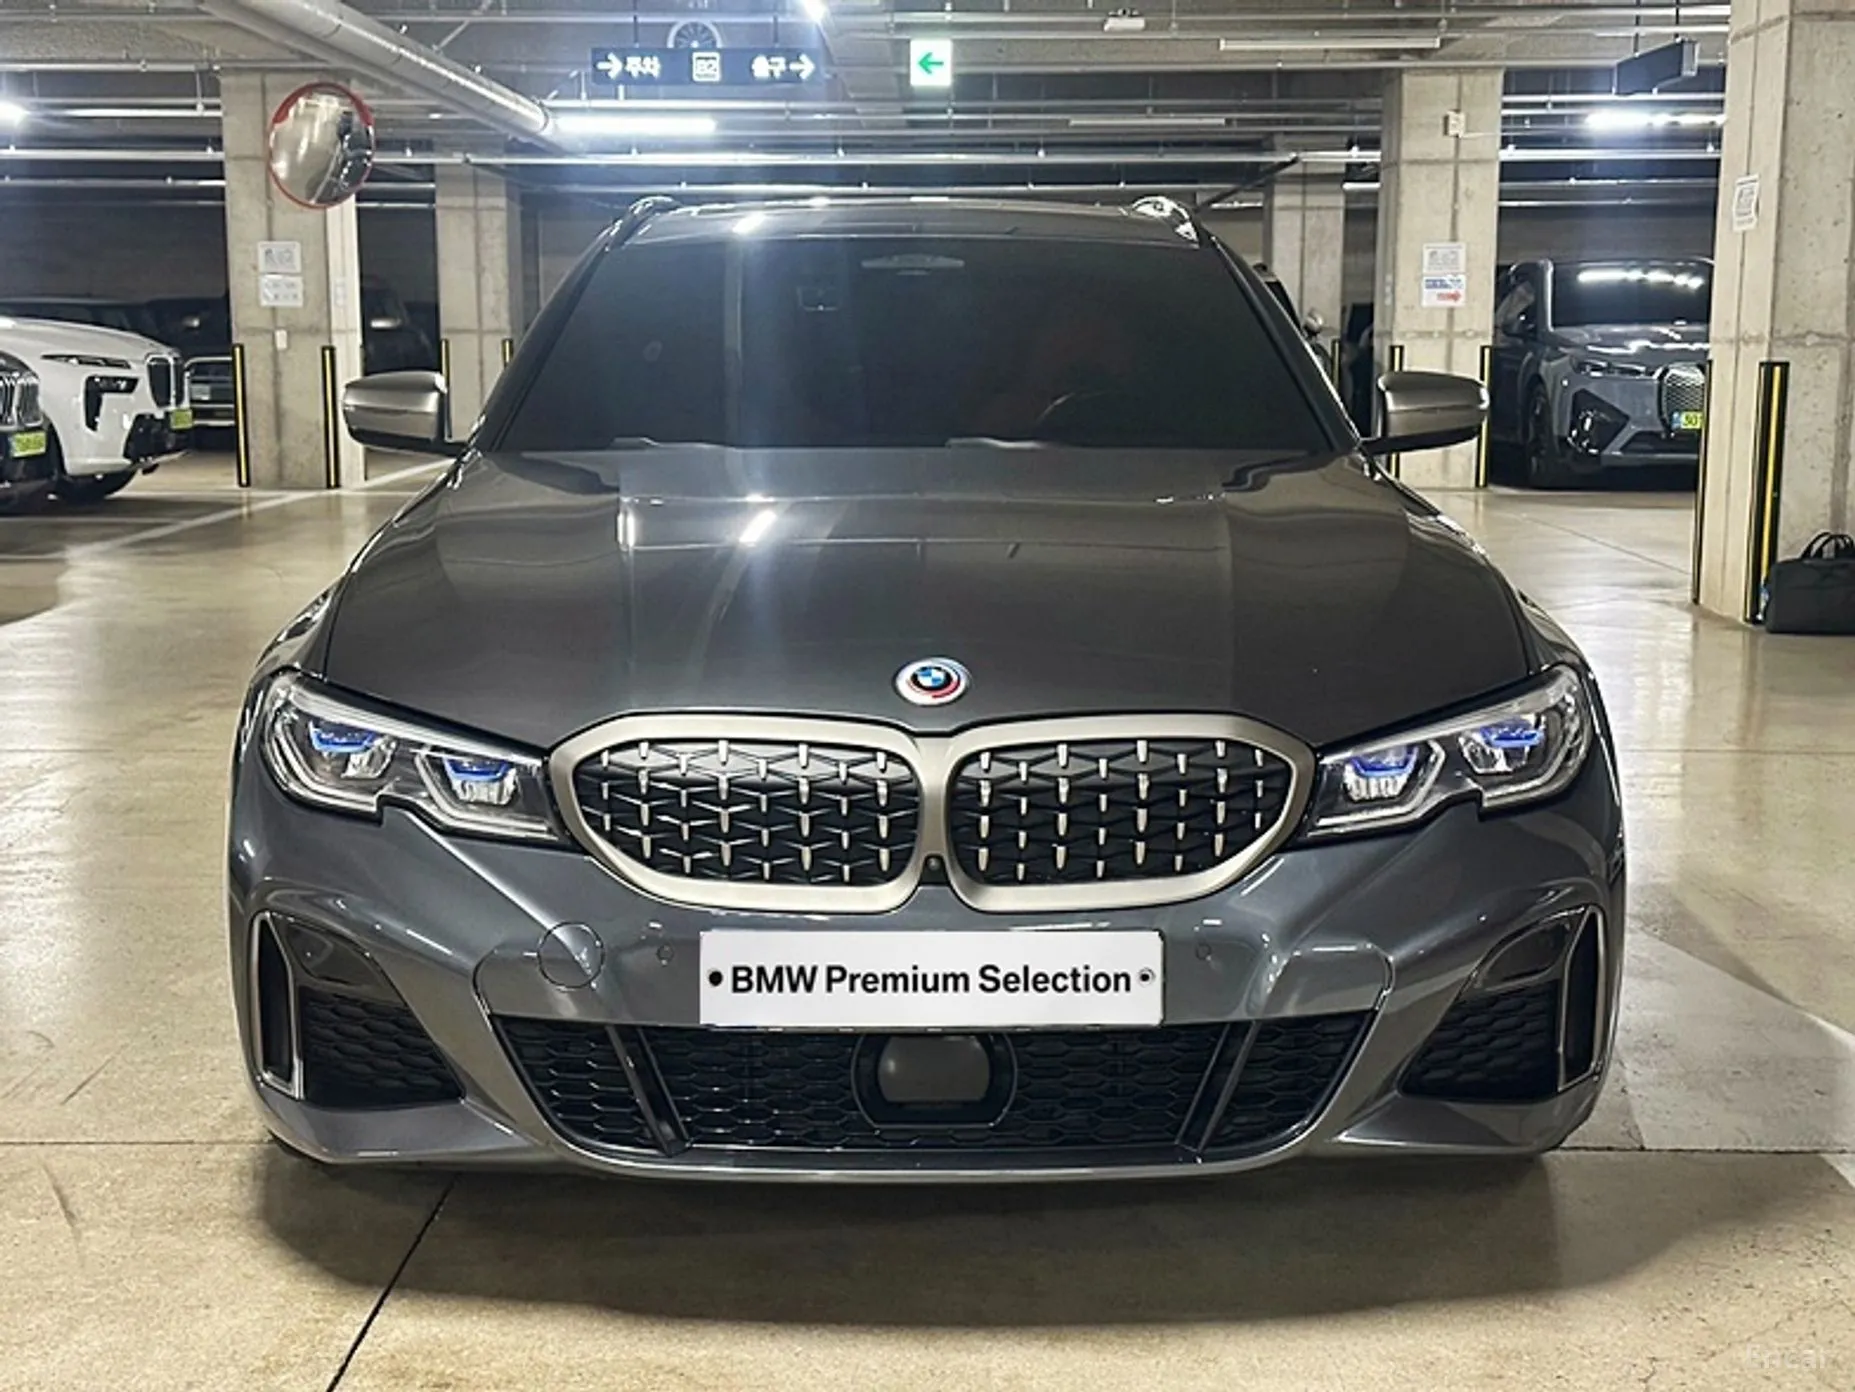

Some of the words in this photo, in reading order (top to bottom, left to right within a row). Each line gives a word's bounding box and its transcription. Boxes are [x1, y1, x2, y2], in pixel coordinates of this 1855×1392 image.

[731, 966, 819, 994] BMW
[826, 965, 970, 994] Premium
[978, 964, 1132, 994] Selection
